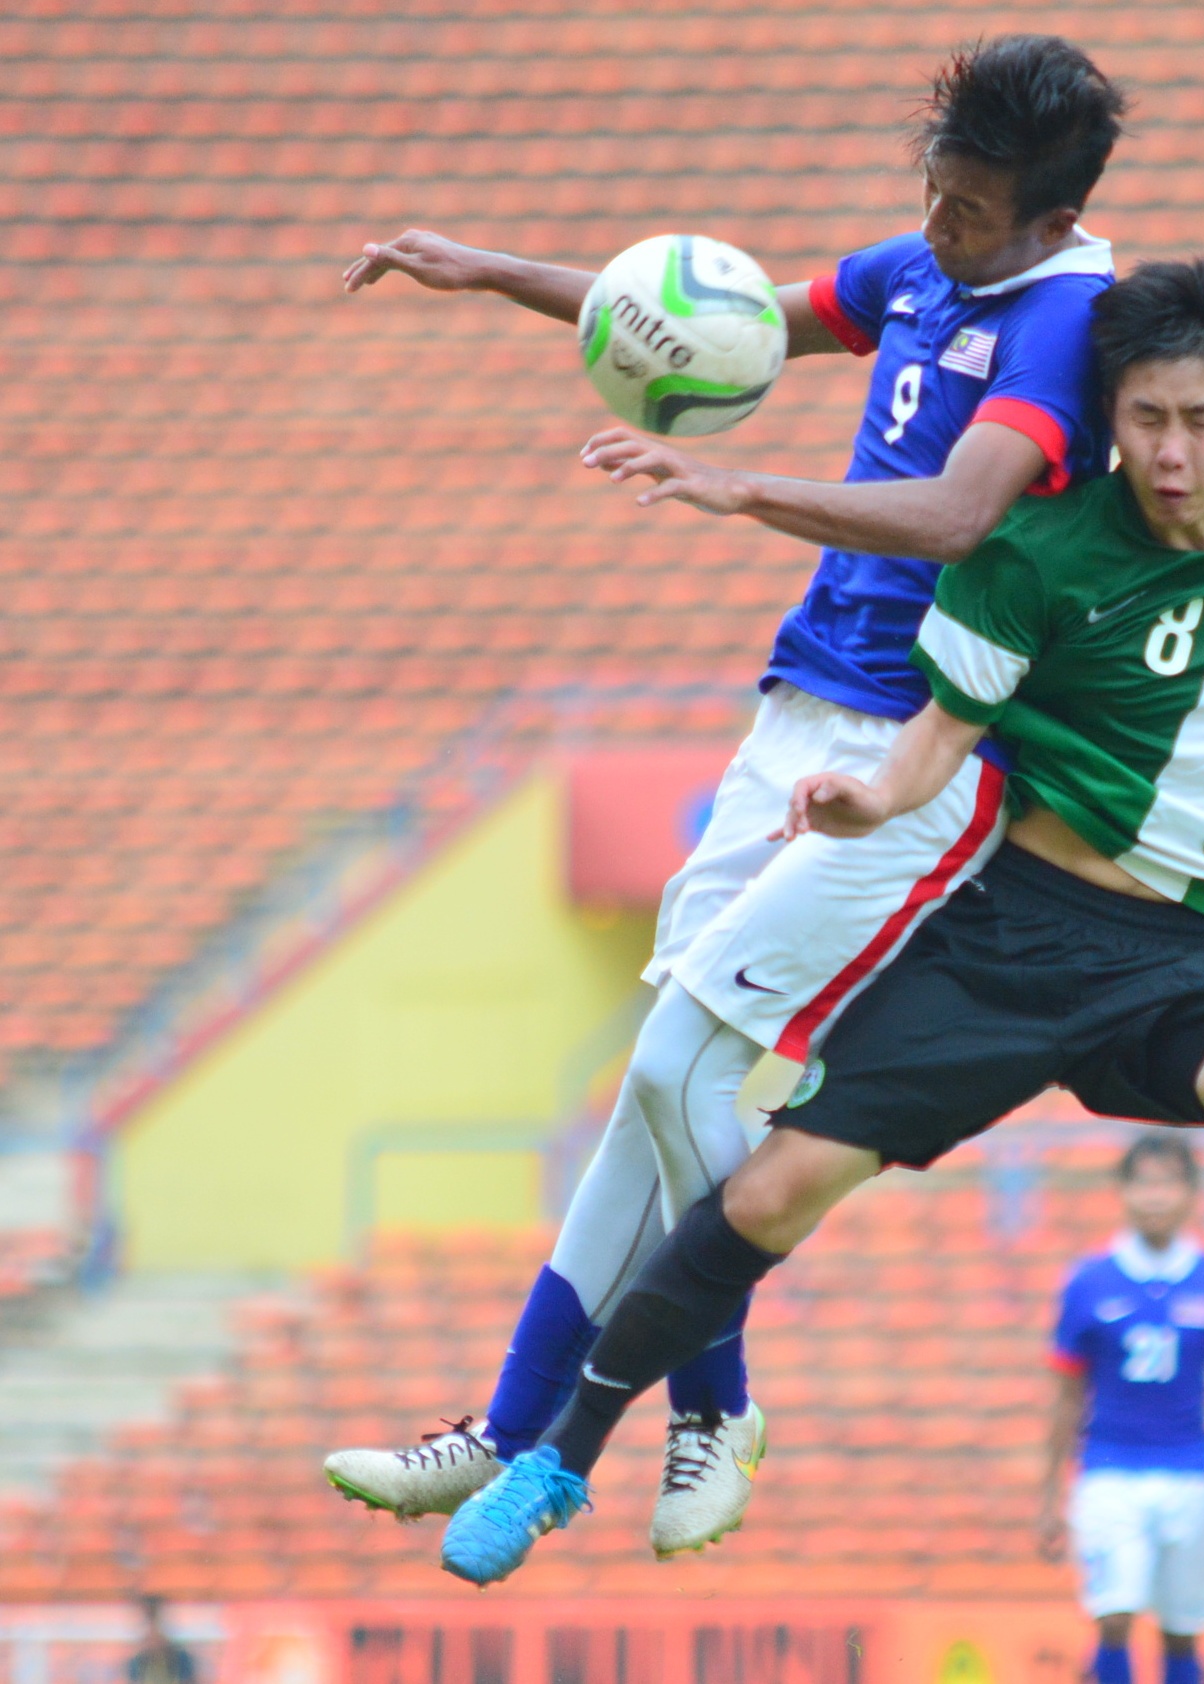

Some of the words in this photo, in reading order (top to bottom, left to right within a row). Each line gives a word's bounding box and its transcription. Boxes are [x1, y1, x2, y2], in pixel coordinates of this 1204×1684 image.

[610, 294, 696, 369] mitre
[883, 364, 923, 446] 9
[1144, 597, 1204, 676] 8
[1120, 1323, 1179, 1383] 21
